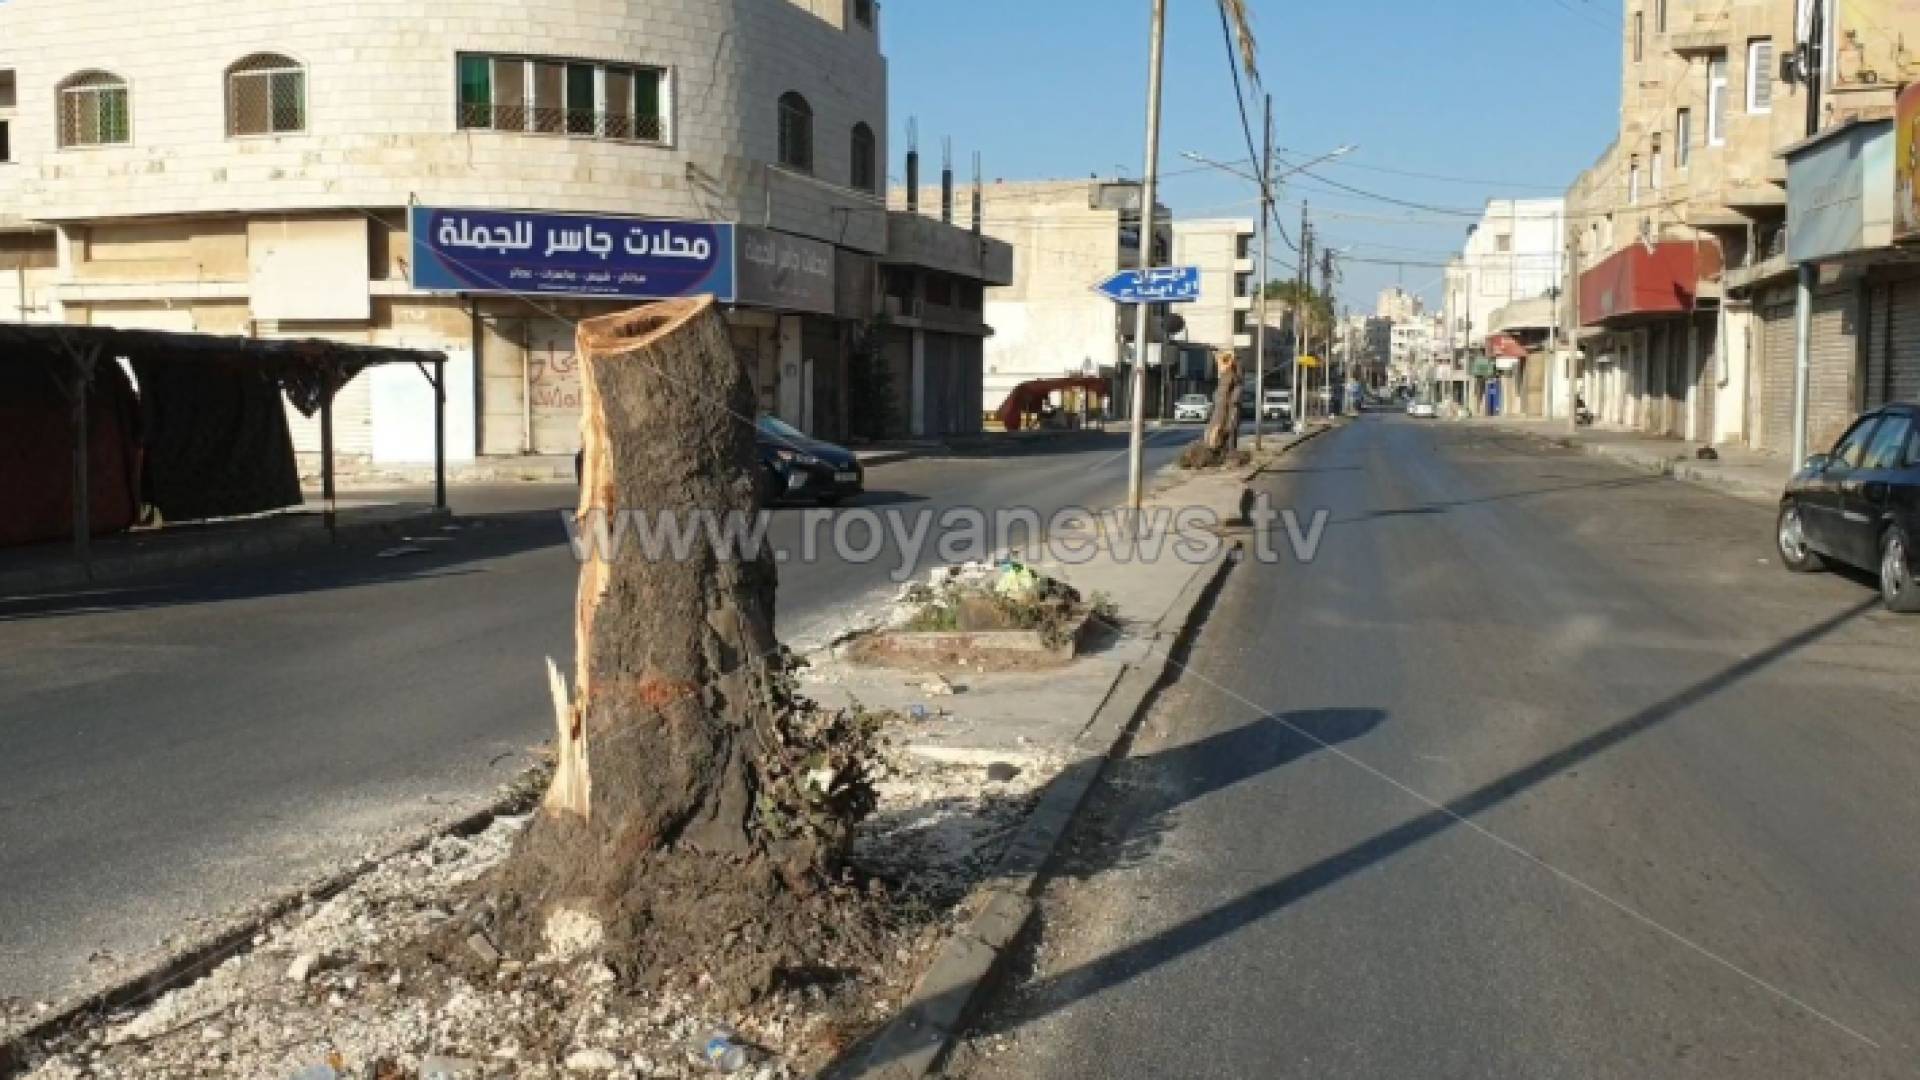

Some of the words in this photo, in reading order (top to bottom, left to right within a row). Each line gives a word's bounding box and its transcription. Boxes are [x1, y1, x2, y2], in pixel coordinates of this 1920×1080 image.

[438, 218, 534, 250] للجملة
[545, 227, 613, 258] جاسر
[624, 228, 711, 261] محلات
